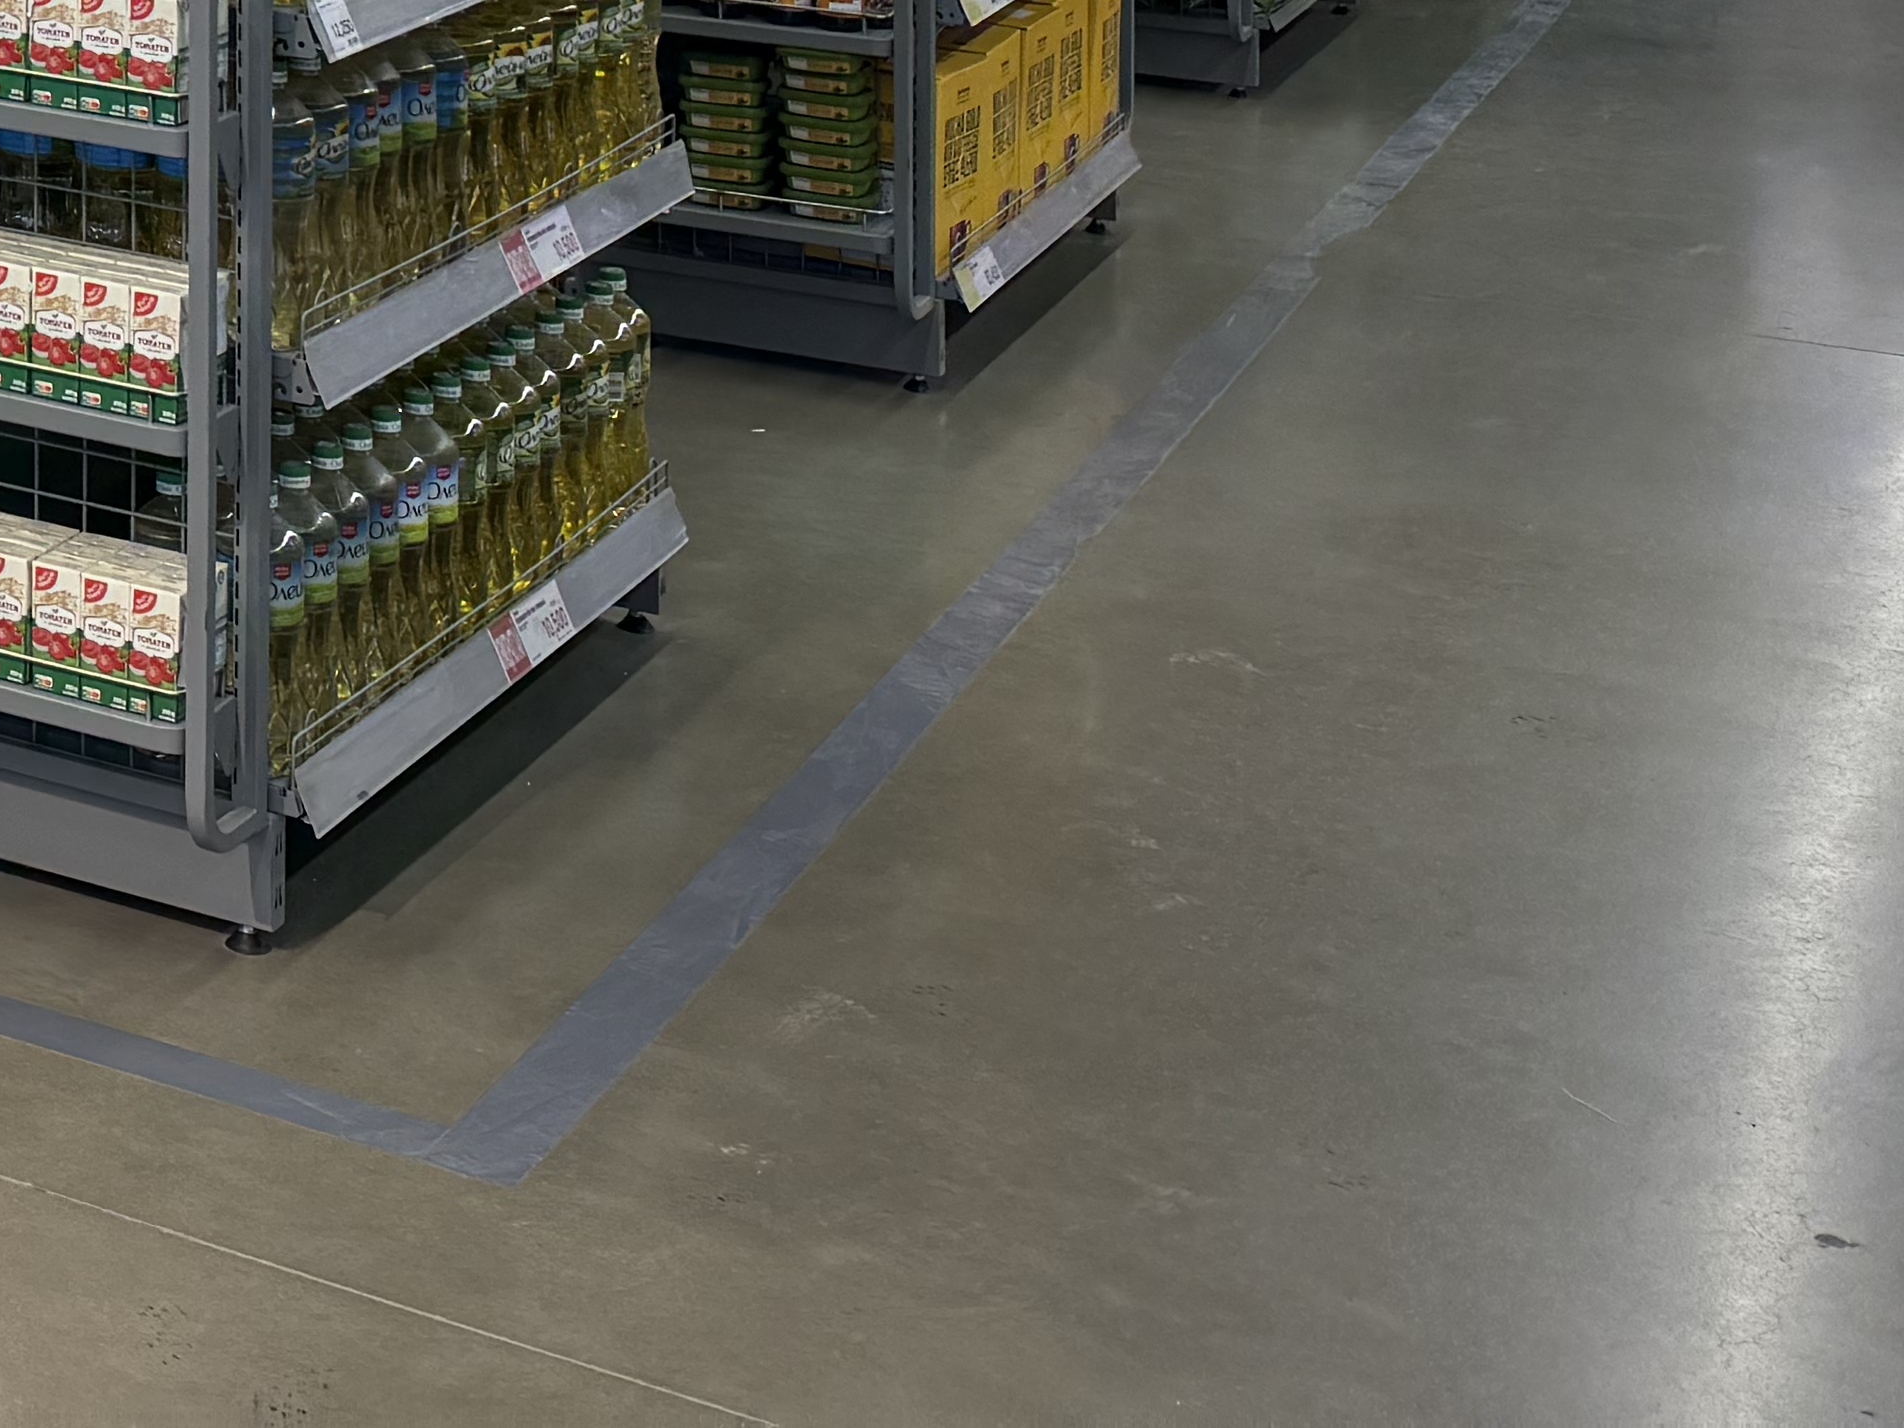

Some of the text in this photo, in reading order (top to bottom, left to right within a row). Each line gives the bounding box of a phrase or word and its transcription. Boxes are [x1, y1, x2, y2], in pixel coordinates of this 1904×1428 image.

[39, 316, 74, 331] TOMATEN
[87, 326, 123, 342] TOMATEN
[136, 336, 173, 351] TOMATEN
[39, 610, 74, 626] TOMATEN
[87, 622, 124, 638] TOMATEN
[136, 634, 173, 651] TOMATEN
